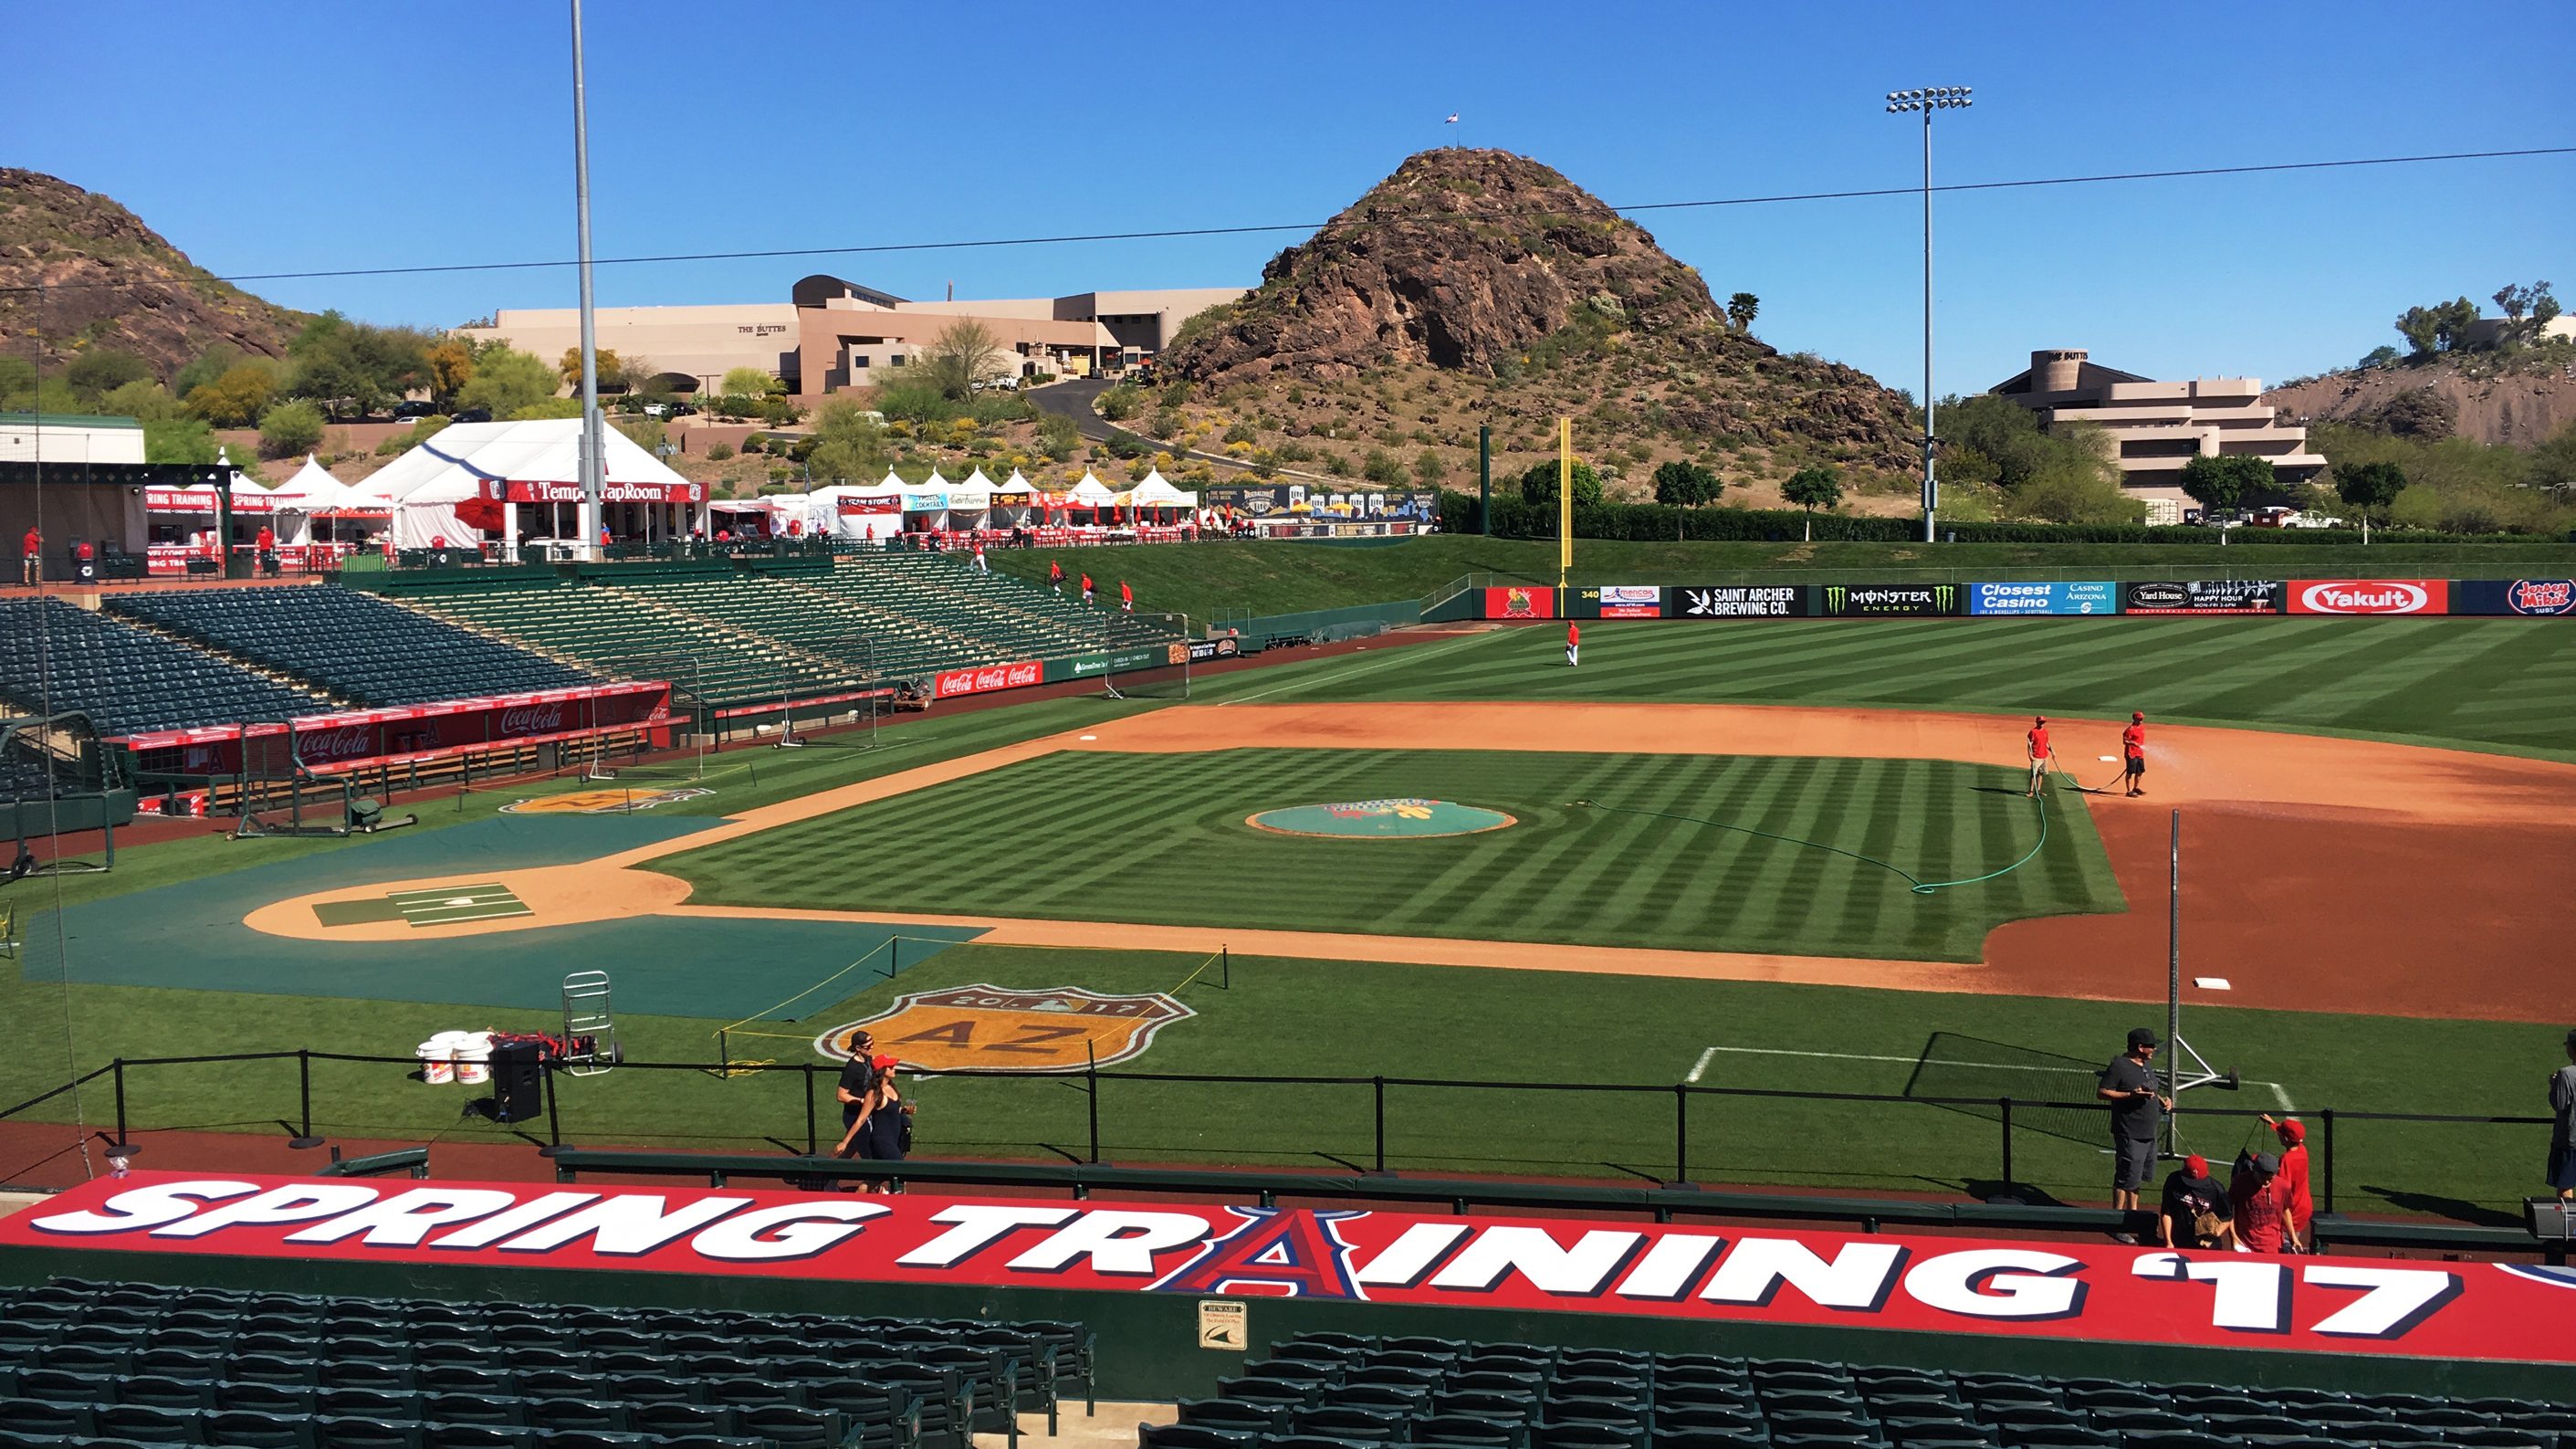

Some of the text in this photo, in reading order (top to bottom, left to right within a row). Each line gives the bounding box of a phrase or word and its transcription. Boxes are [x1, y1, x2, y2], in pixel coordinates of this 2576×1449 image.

[756, 325, 786, 333] BUTTES
[147, 493, 212, 505] RING TRAINING
[1291, 490, 1303, 499] Lite
[233, 496, 264, 507] SPRING
[868, 498, 892, 506] STORE
[1581, 591, 1599, 599] 340
[1714, 588, 1795, 602] SAINT ARCHER
[1981, 584, 2052, 596] Closest
[2140, 591, 2183, 600] Yard House
[2517, 582, 2570, 597] Jersey
[1850, 589, 1932, 604] MONSTER
[1983, 596, 2048, 608] Casino
[2321, 590, 2409, 607] Yakult
[2521, 592, 2570, 609] Mike's
[1715, 601, 1789, 615] BREWING CO.
[951, 996, 1137, 1013] 20 17
[887, 1020, 1089, 1054] AZ
[30, 1181, 2466, 1341] SPRING TRAINING '17
